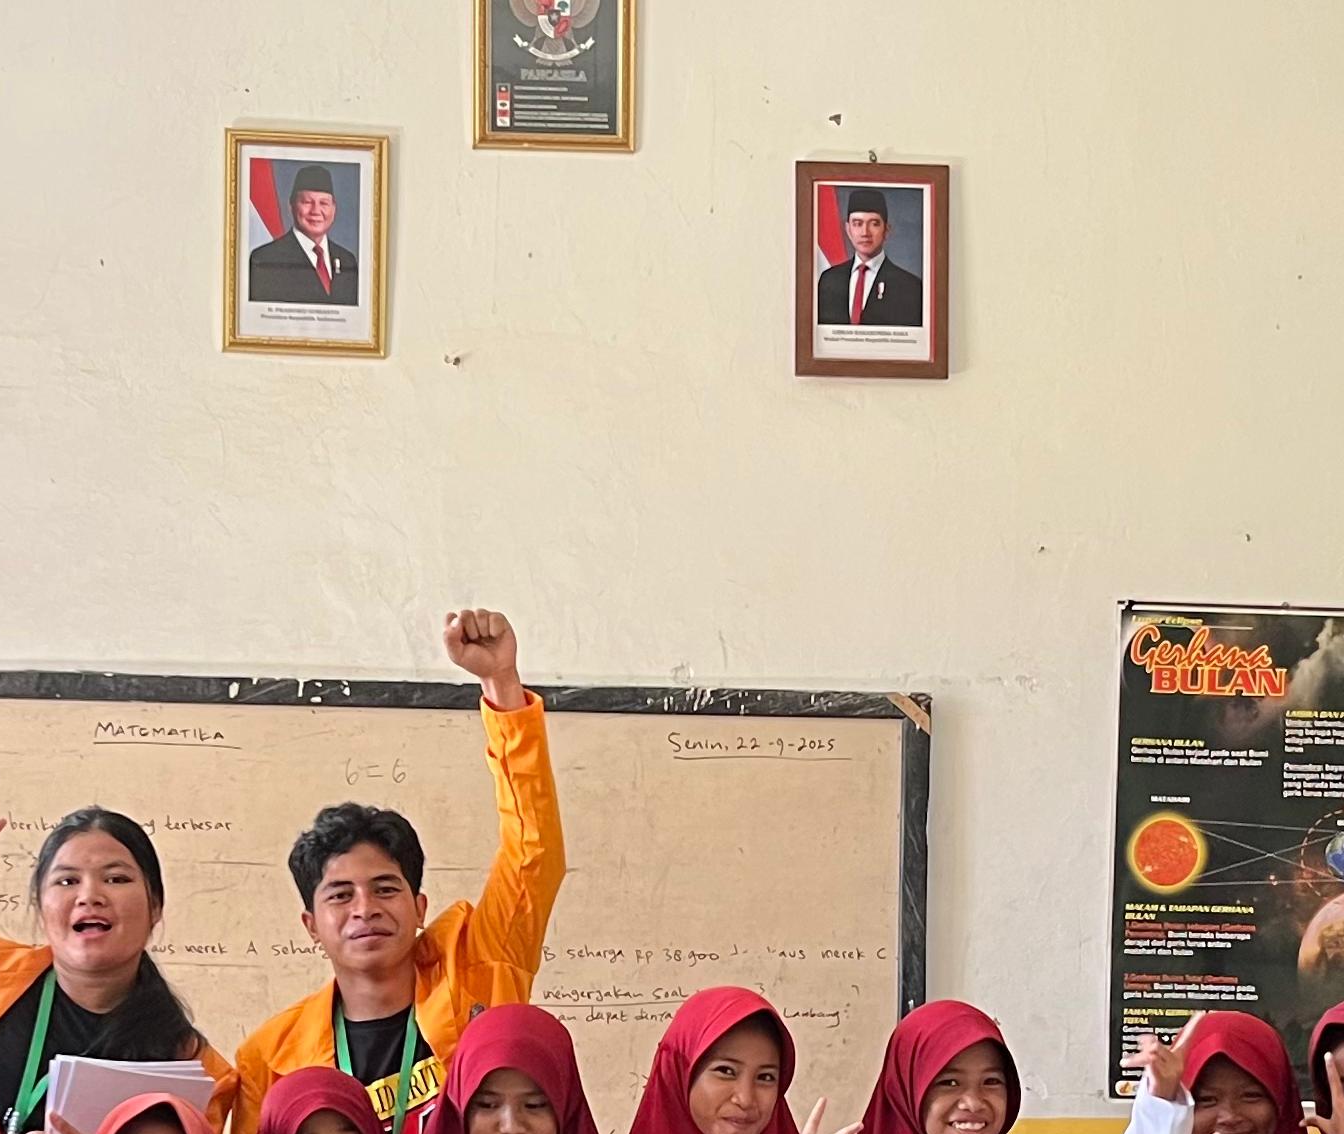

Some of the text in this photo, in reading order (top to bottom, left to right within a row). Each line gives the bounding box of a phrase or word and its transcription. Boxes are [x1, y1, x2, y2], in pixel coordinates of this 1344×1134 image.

[520, 68, 587, 82] PANCASILA
[1131, 623, 1273, 673] Gerhana
[1151, 665, 1287, 697] BULAN
[94, 721, 224, 741] MATEMATIKA
[736, 737, 760, 750] 22
[151, 942, 176, 955] aus
[246, 941, 259, 955] A
